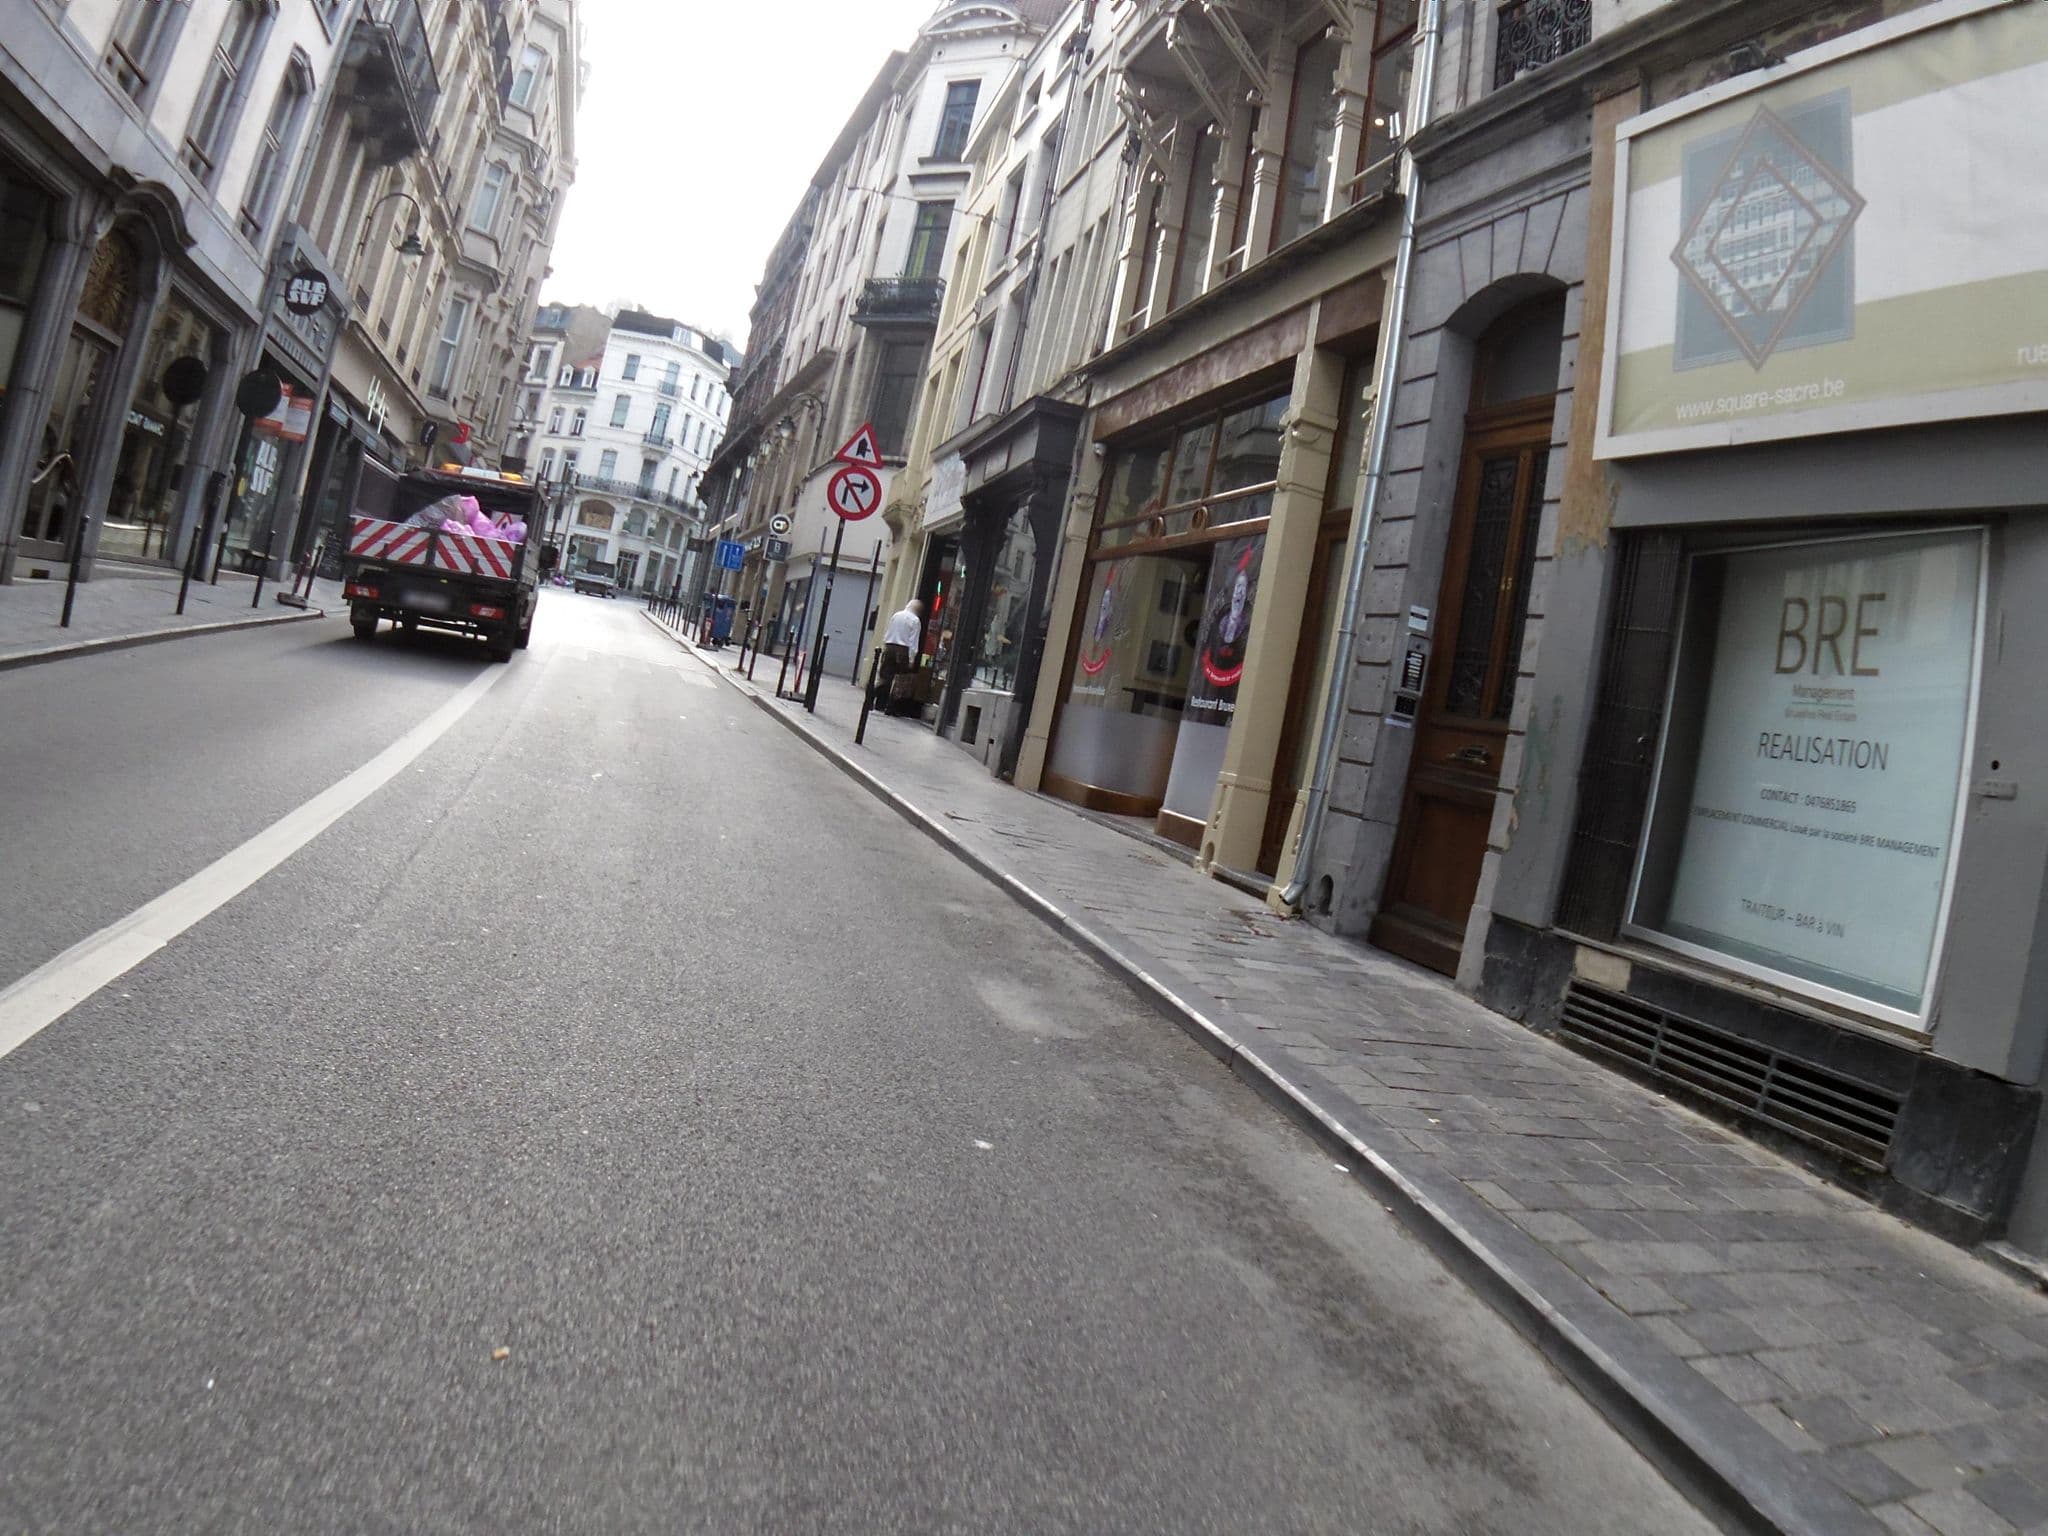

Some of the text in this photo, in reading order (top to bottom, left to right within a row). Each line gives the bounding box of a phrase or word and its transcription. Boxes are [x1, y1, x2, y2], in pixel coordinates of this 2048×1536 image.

[287, 290, 326, 306] SVP
[1676, 377, 1845, 420] www.square-sacre.be
[1774, 592, 1887, 677] BRE
[1757, 731, 1889, 771] REALISATION
[1760, 788, 1799, 804] CONTACT
[1859, 834, 1875, 848] BRE
[1876, 837, 1940, 858] MANAGEMENT
